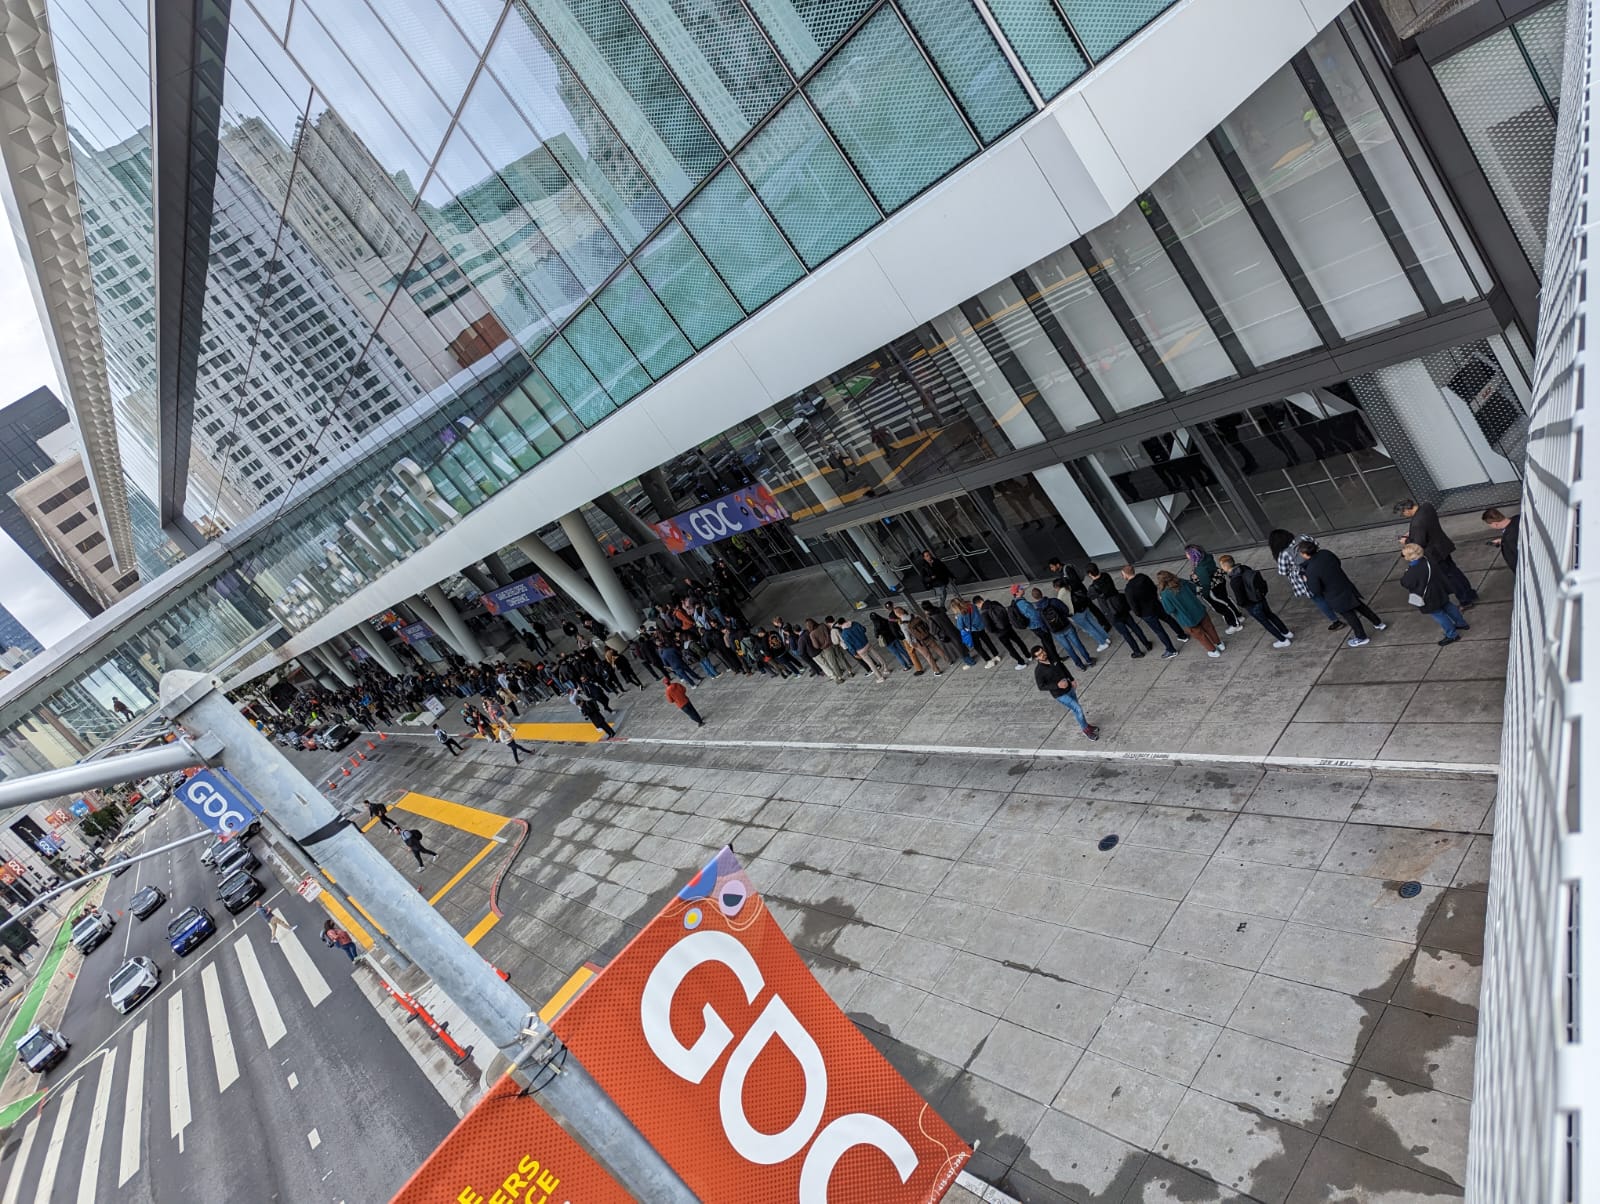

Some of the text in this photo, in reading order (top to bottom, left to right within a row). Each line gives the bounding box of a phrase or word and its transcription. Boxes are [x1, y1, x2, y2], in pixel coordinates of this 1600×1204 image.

[690, 502, 742, 540] GDC
[187, 781, 245, 833] GDC
[39, 840, 54, 854] GDC
[8, 860, 25, 876] GDC
[640, 930, 919, 1204] GDC
